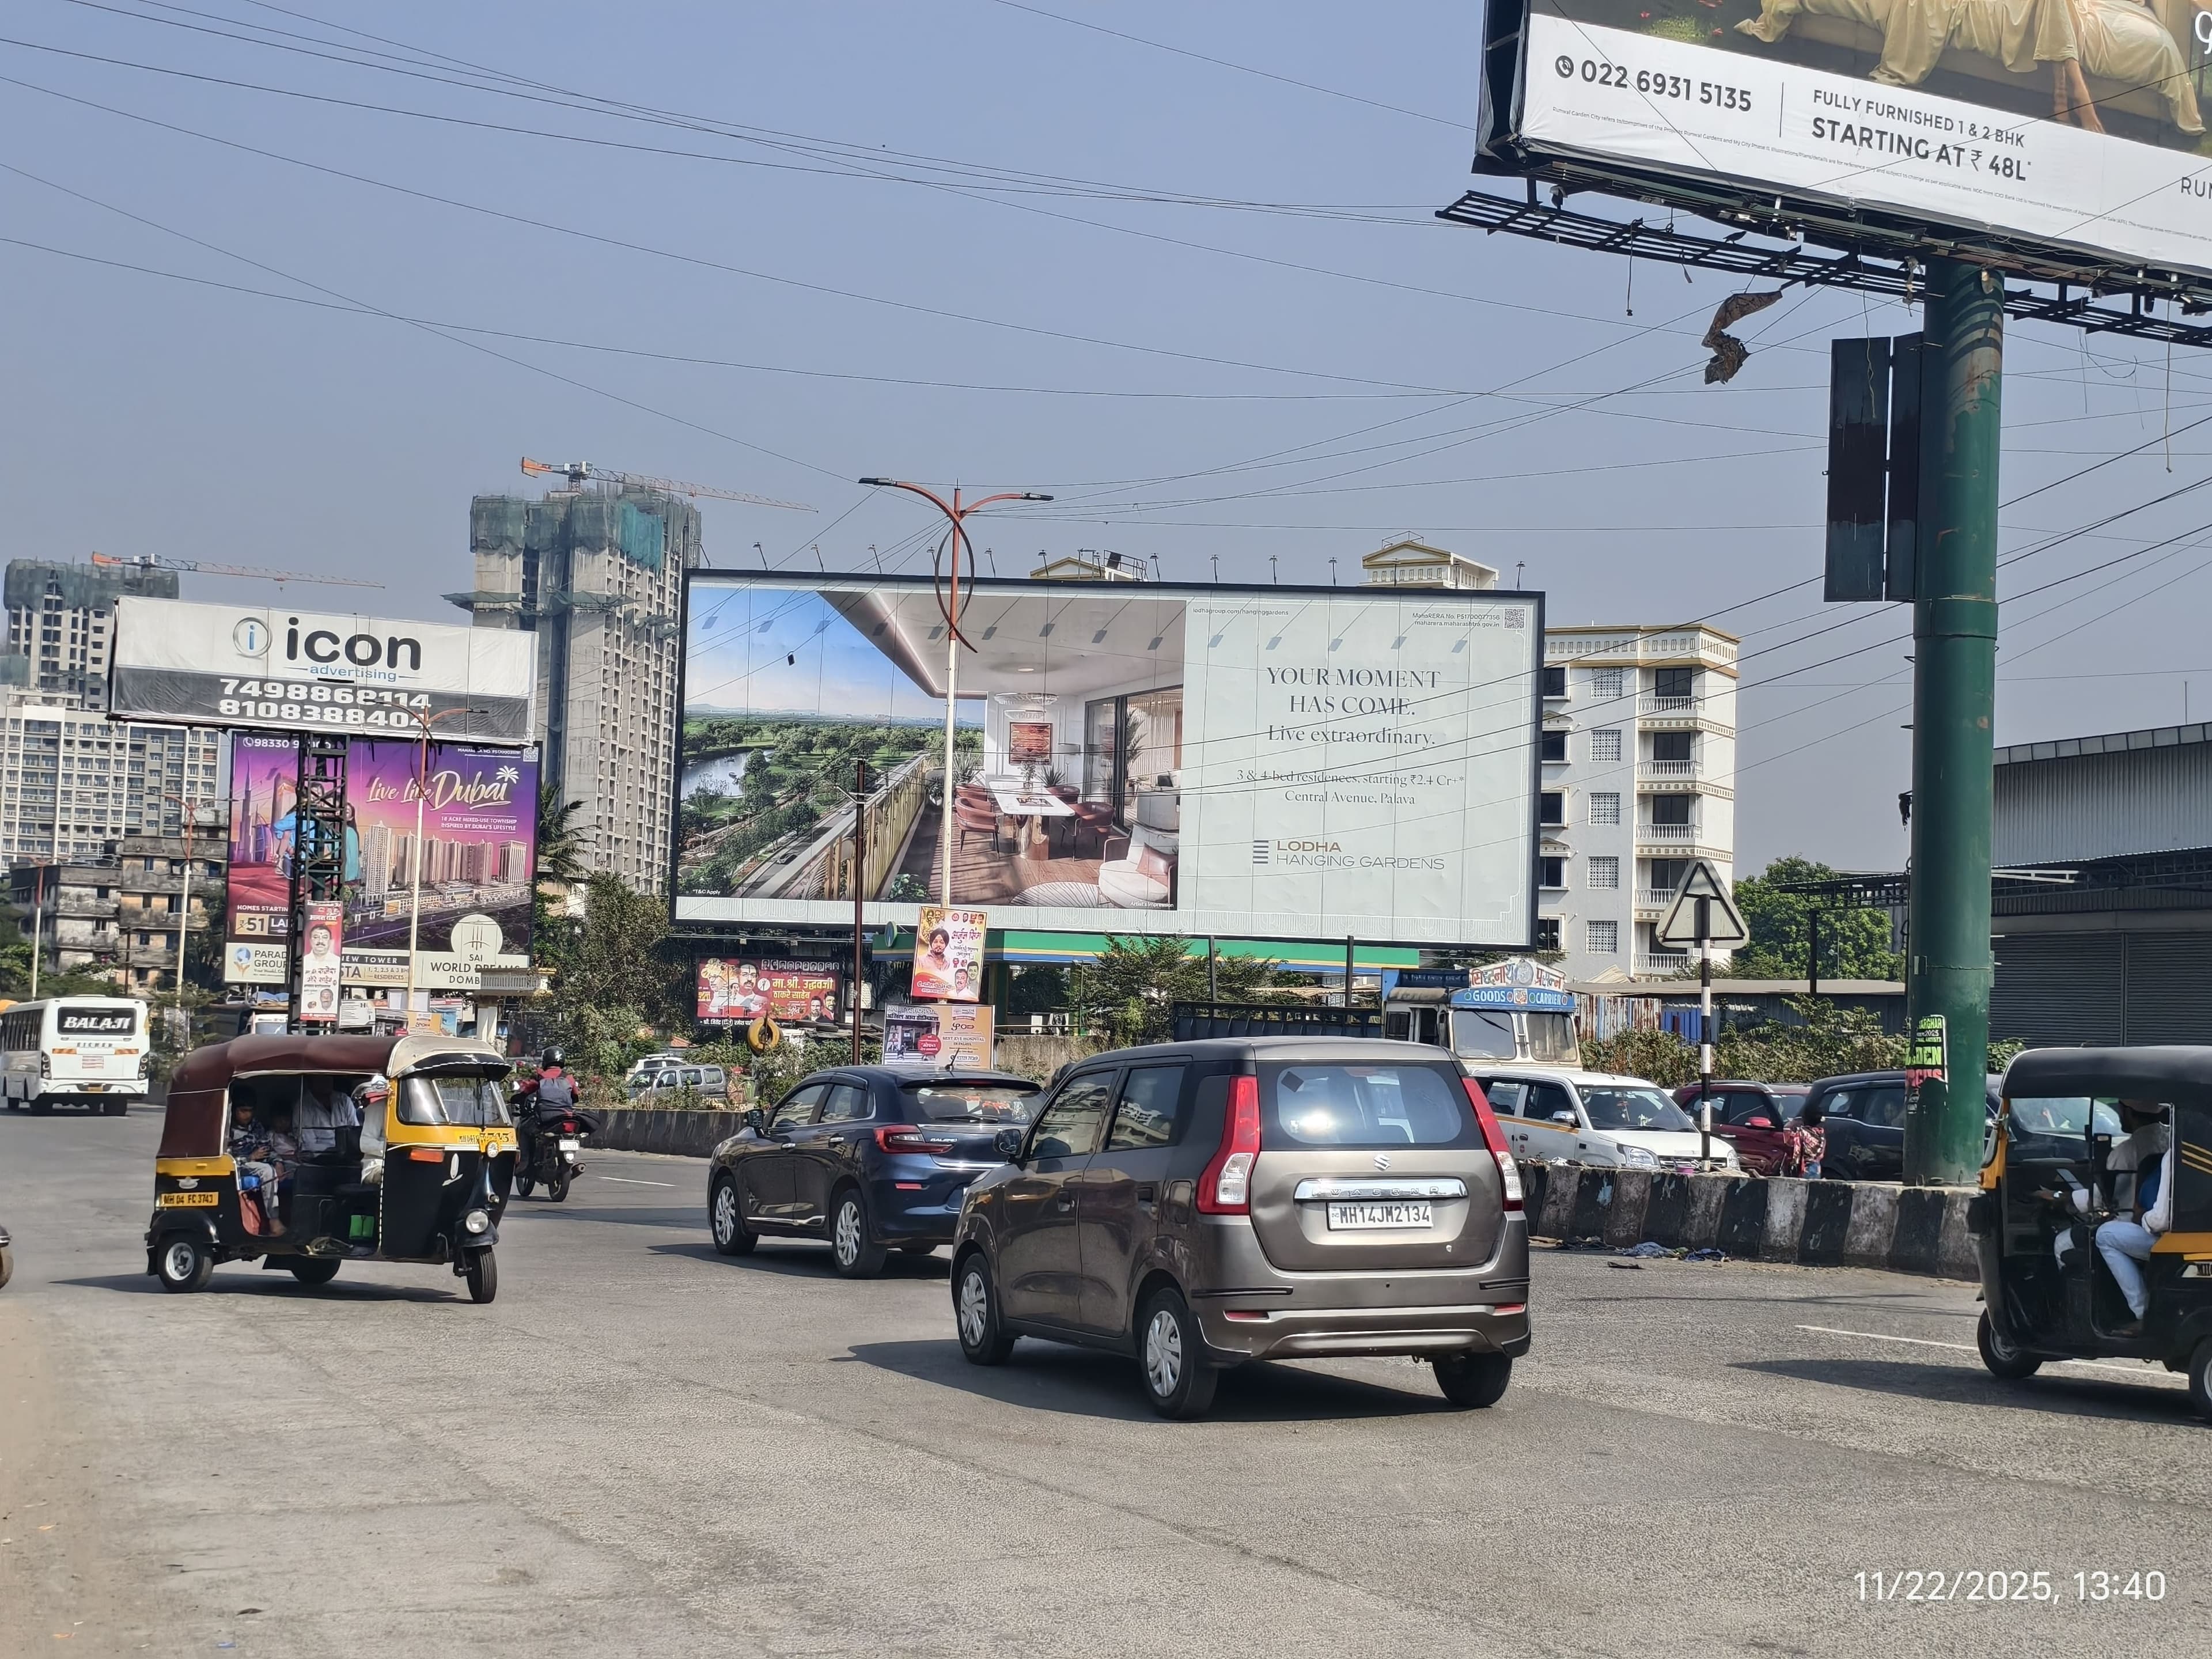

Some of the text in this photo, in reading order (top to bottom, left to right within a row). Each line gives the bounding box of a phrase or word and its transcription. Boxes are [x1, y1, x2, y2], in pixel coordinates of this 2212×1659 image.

[1581, 60, 1751, 112] 022 6931 5135
[1814, 90, 2025, 148] FULLY FURNISHED 1 & 2 BHK
[1812, 117, 1929, 160] STARTING
[1936, 144, 1965, 167] AT
[2181, 177, 2212, 199] RU
[287, 617, 421, 671] icon
[310, 665, 396, 682] advertising
[1267, 667, 1441, 688] YOUR MOMENT
[1290, 695, 1415, 715] HAS COME.
[255, 738, 289, 748] 98330
[1268, 725, 1435, 749] Live extraordinary.
[1237, 770, 1243, 780] 3
[1247, 770, 1256, 781] &
[1260, 770, 1294, 782] 4-bed
[1297, 771, 1360, 784] residences,
[1363, 774, 1407, 788] starting
[1411, 774, 1434, 785] ₹2.4
[366, 770, 512, 810] Live Lie Dubai
[1285, 790, 1415, 805] Central Avenue, Palava
[1277, 840, 1342, 853] LODHA
[1277, 854, 1445, 870] HANGING GARDENS
[271, 918, 288, 927] LA
[431, 963, 471, 973] WORLD
[1473, 990, 1561, 1005] GOODS CARRIER
[63, 1016, 131, 1029] BALAJI
[1429, 1186, 1439, 1194] R
[1340, 1206, 1430, 1224] MH14JM2134
